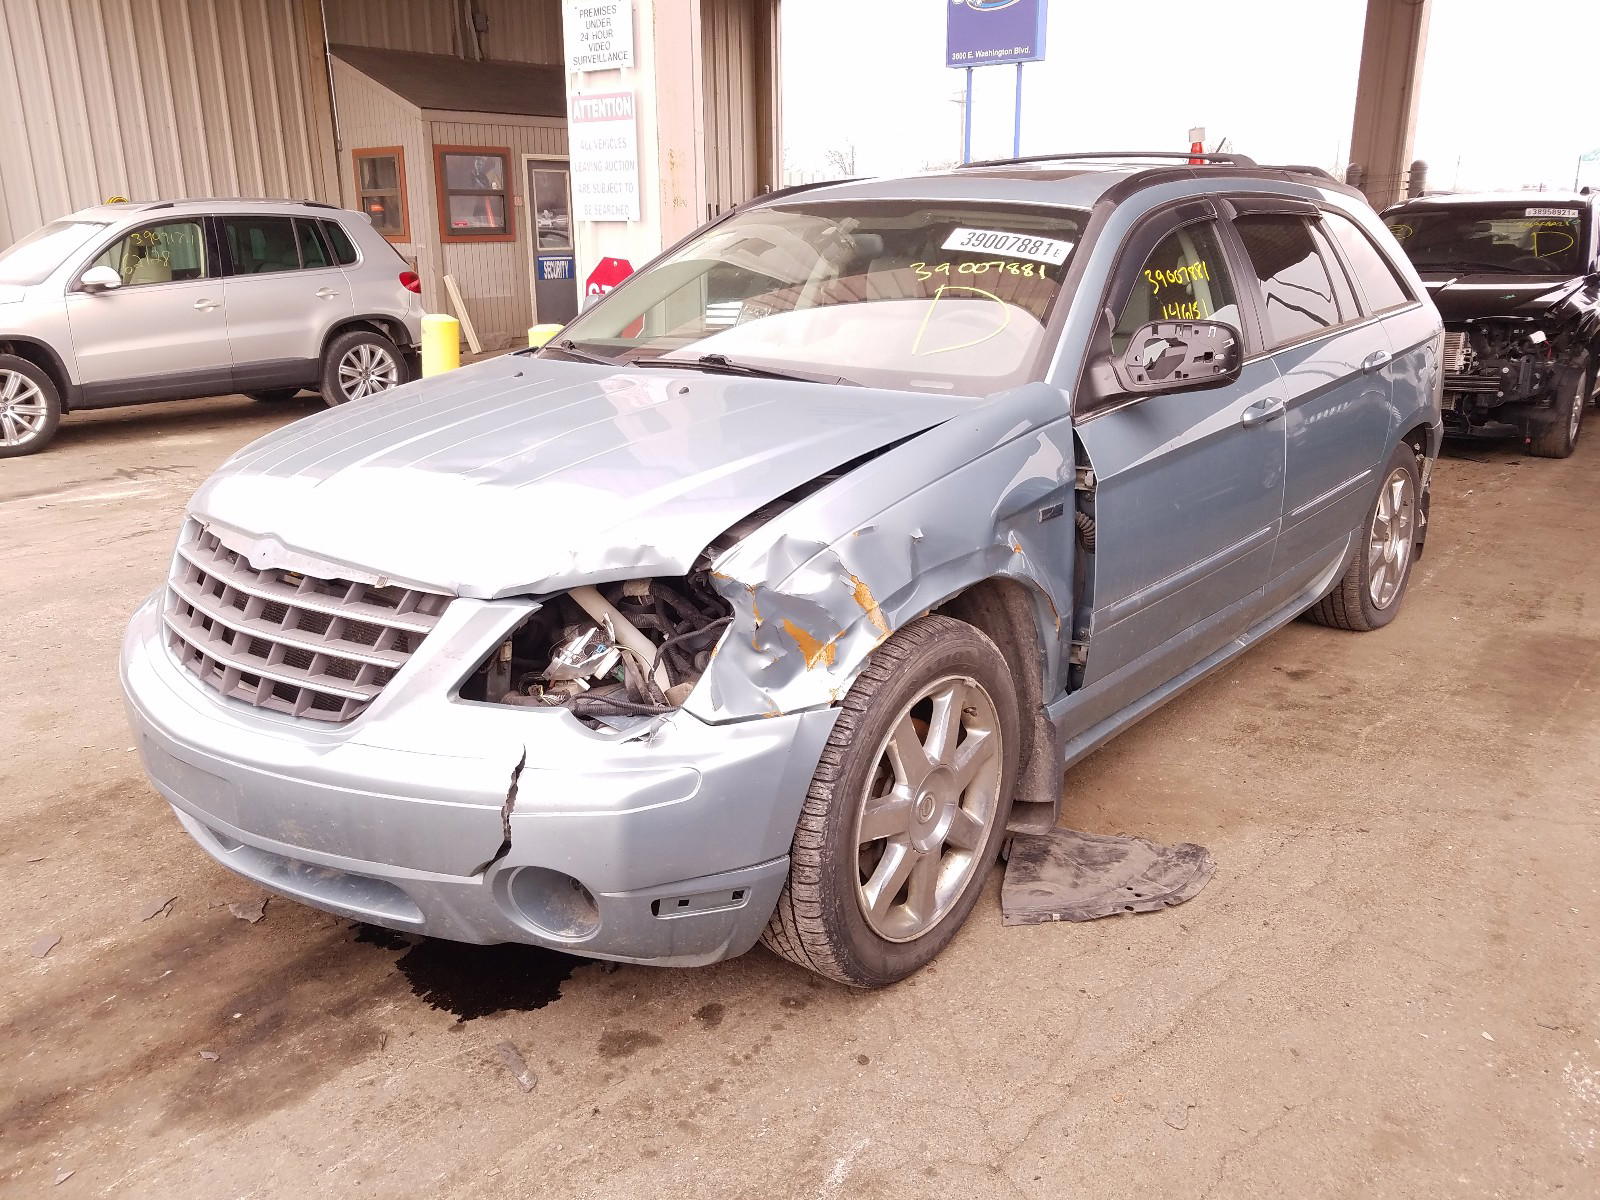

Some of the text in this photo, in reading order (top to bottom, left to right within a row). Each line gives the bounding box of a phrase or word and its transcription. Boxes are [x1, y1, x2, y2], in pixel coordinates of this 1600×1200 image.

[579, 5, 617, 18] PREMISES
[585, 18, 611, 29] UNDER
[580, 30, 613, 42] 24 HOUR
[588, 41, 611, 52] VIDEO
[967, 50, 974, 59] E.
[975, 48, 1013, 57] Washington
[1014, 46, 1031, 55] Blvd.
[573, 51, 629, 66] SURVEILLANCE
[573, 99, 633, 120] ATTENTION
[580, 137, 627, 150] ALL VEHICLES
[574, 159, 635, 173] LEAVING AUCTION
[578, 182, 634, 194] ARE SUBJECT TO
[584, 204, 629, 215] BE SEARCHED
[960, 231, 1054, 256] 39007881
[543, 260, 569, 280] SECURITY
